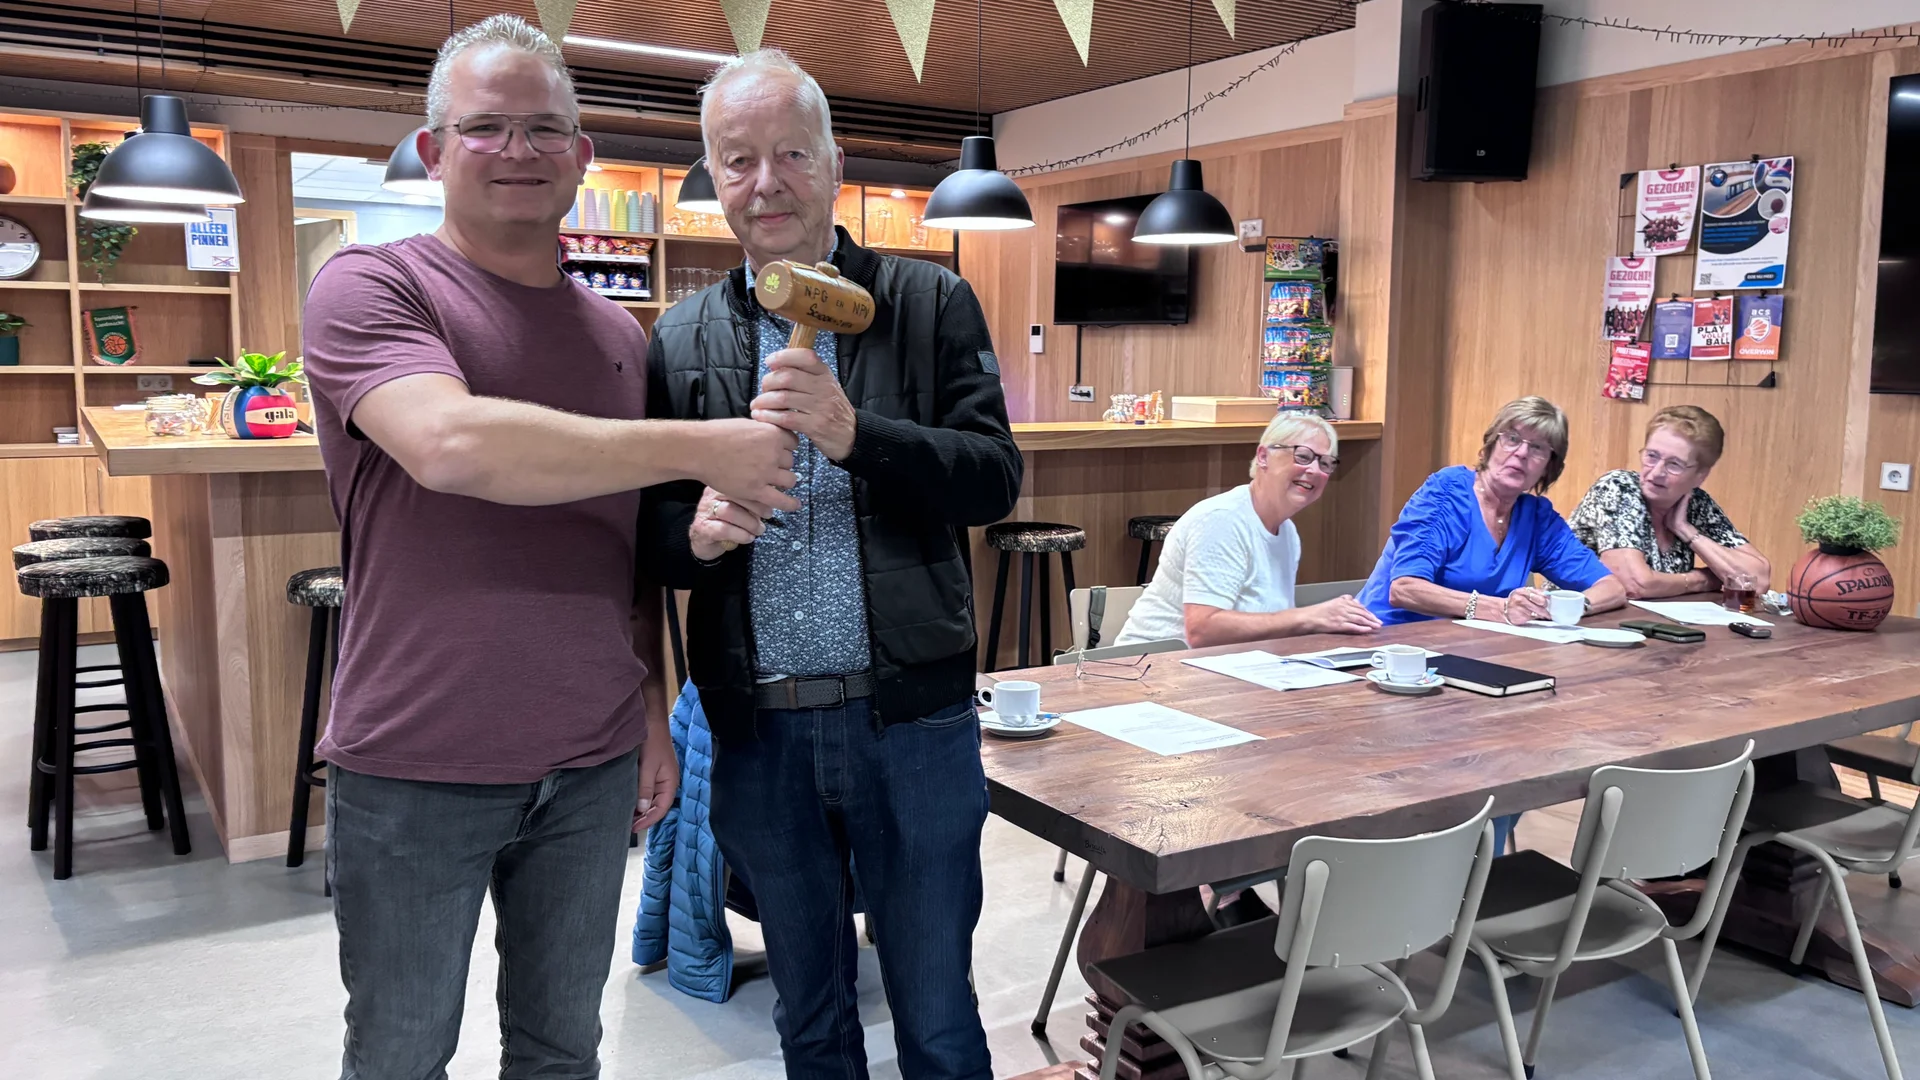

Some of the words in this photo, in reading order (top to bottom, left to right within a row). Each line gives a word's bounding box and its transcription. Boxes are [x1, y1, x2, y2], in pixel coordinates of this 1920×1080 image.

[1647, 181, 1695, 194] GEZOCHT!
[190, 222, 228, 234] ALLEEN
[191, 235, 229, 246] PINNEN
[1610, 270, 1651, 281] GEZOCHT!
[804, 285, 828, 303] NPG
[1697, 326, 1725, 334] PLAY
[1706, 338, 1730, 346] BALL
[264, 408, 295, 423] gala
[1834, 574, 1894, 596] SPALDIN
